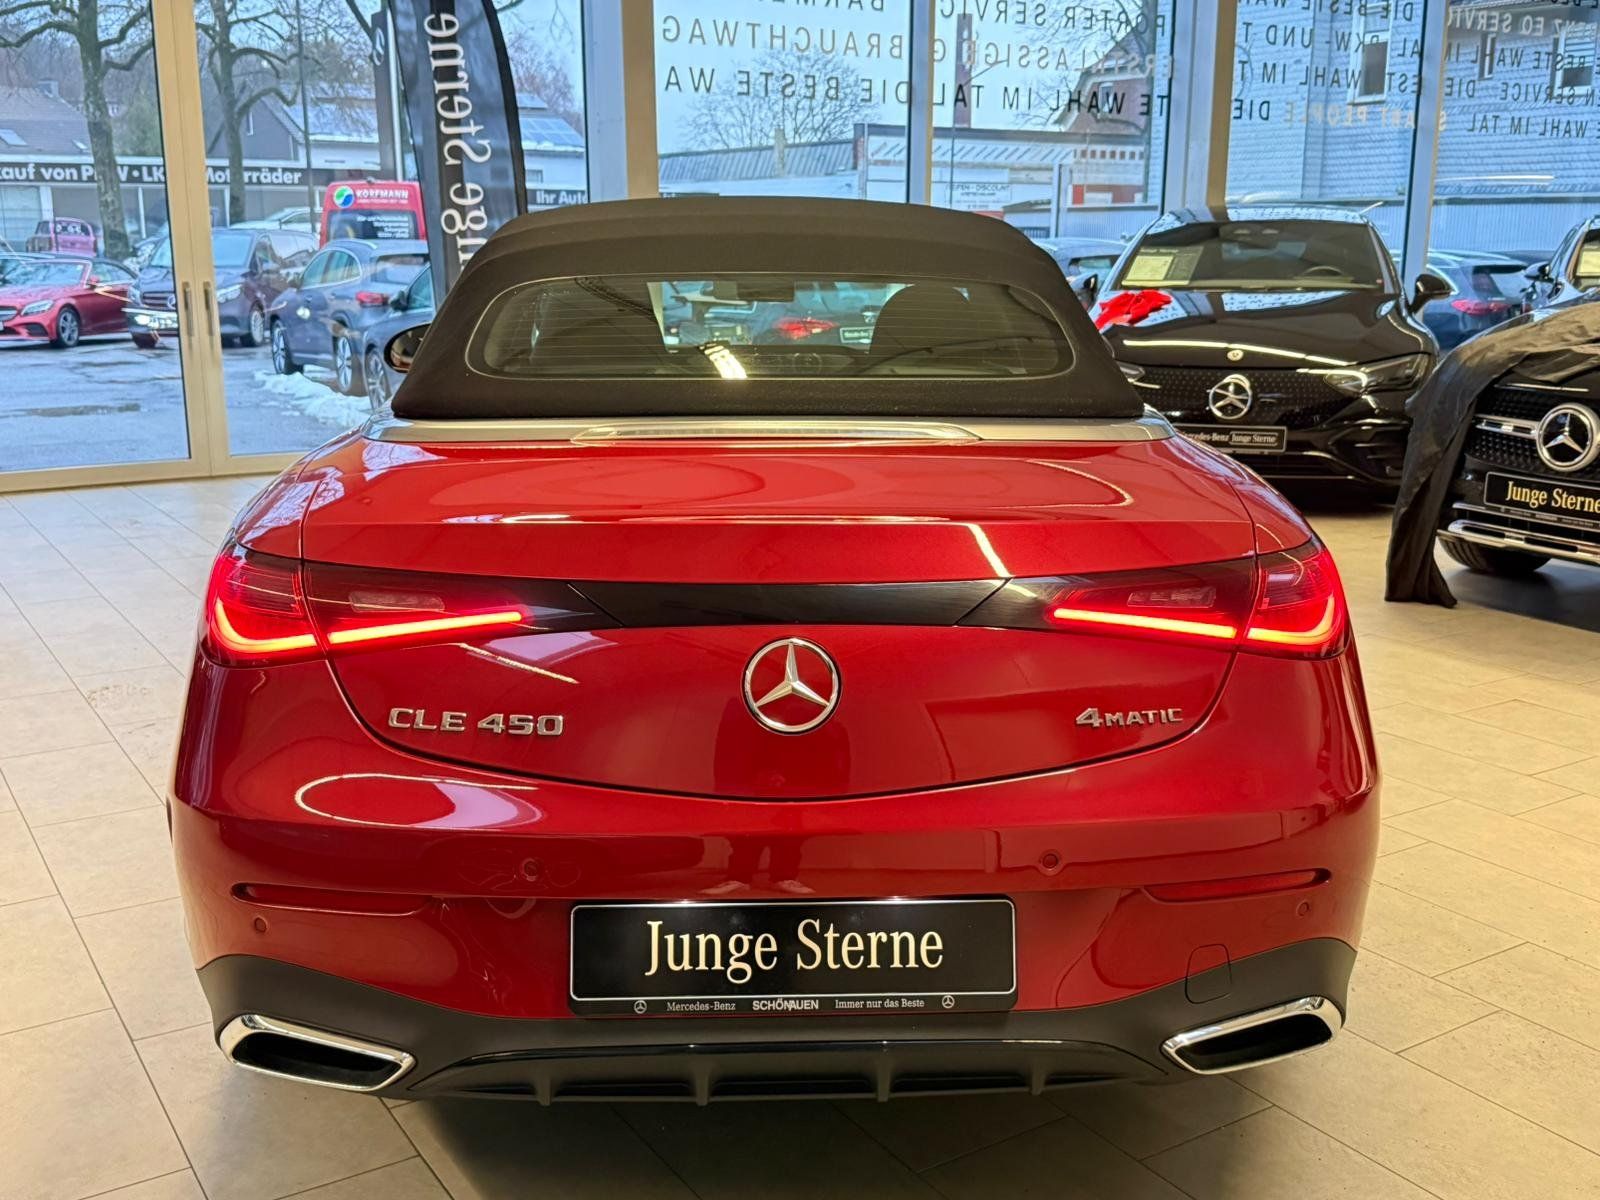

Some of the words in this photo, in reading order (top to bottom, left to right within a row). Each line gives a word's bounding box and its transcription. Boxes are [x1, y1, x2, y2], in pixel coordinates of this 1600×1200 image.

[40, 164, 78, 182] von
[81, 164, 129, 182] PW
[142, 165, 166, 183] LK
[536, 190, 557, 204] Ihr
[1505, 481, 1548, 509] Junge
[1551, 487, 1600, 514] Sterne
[387, 706, 467, 732] CLE
[477, 712, 564, 736] 450
[644, 919, 778, 984] Junge
[796, 917, 944, 971] Sterne
[666, 1001, 736, 1012] Mercedes-Benz
[835, 999, 865, 1009] Immer
[866, 1000, 882, 1009] nur
[884, 998, 900, 1009] das
[901, 997, 925, 1008] Beste
